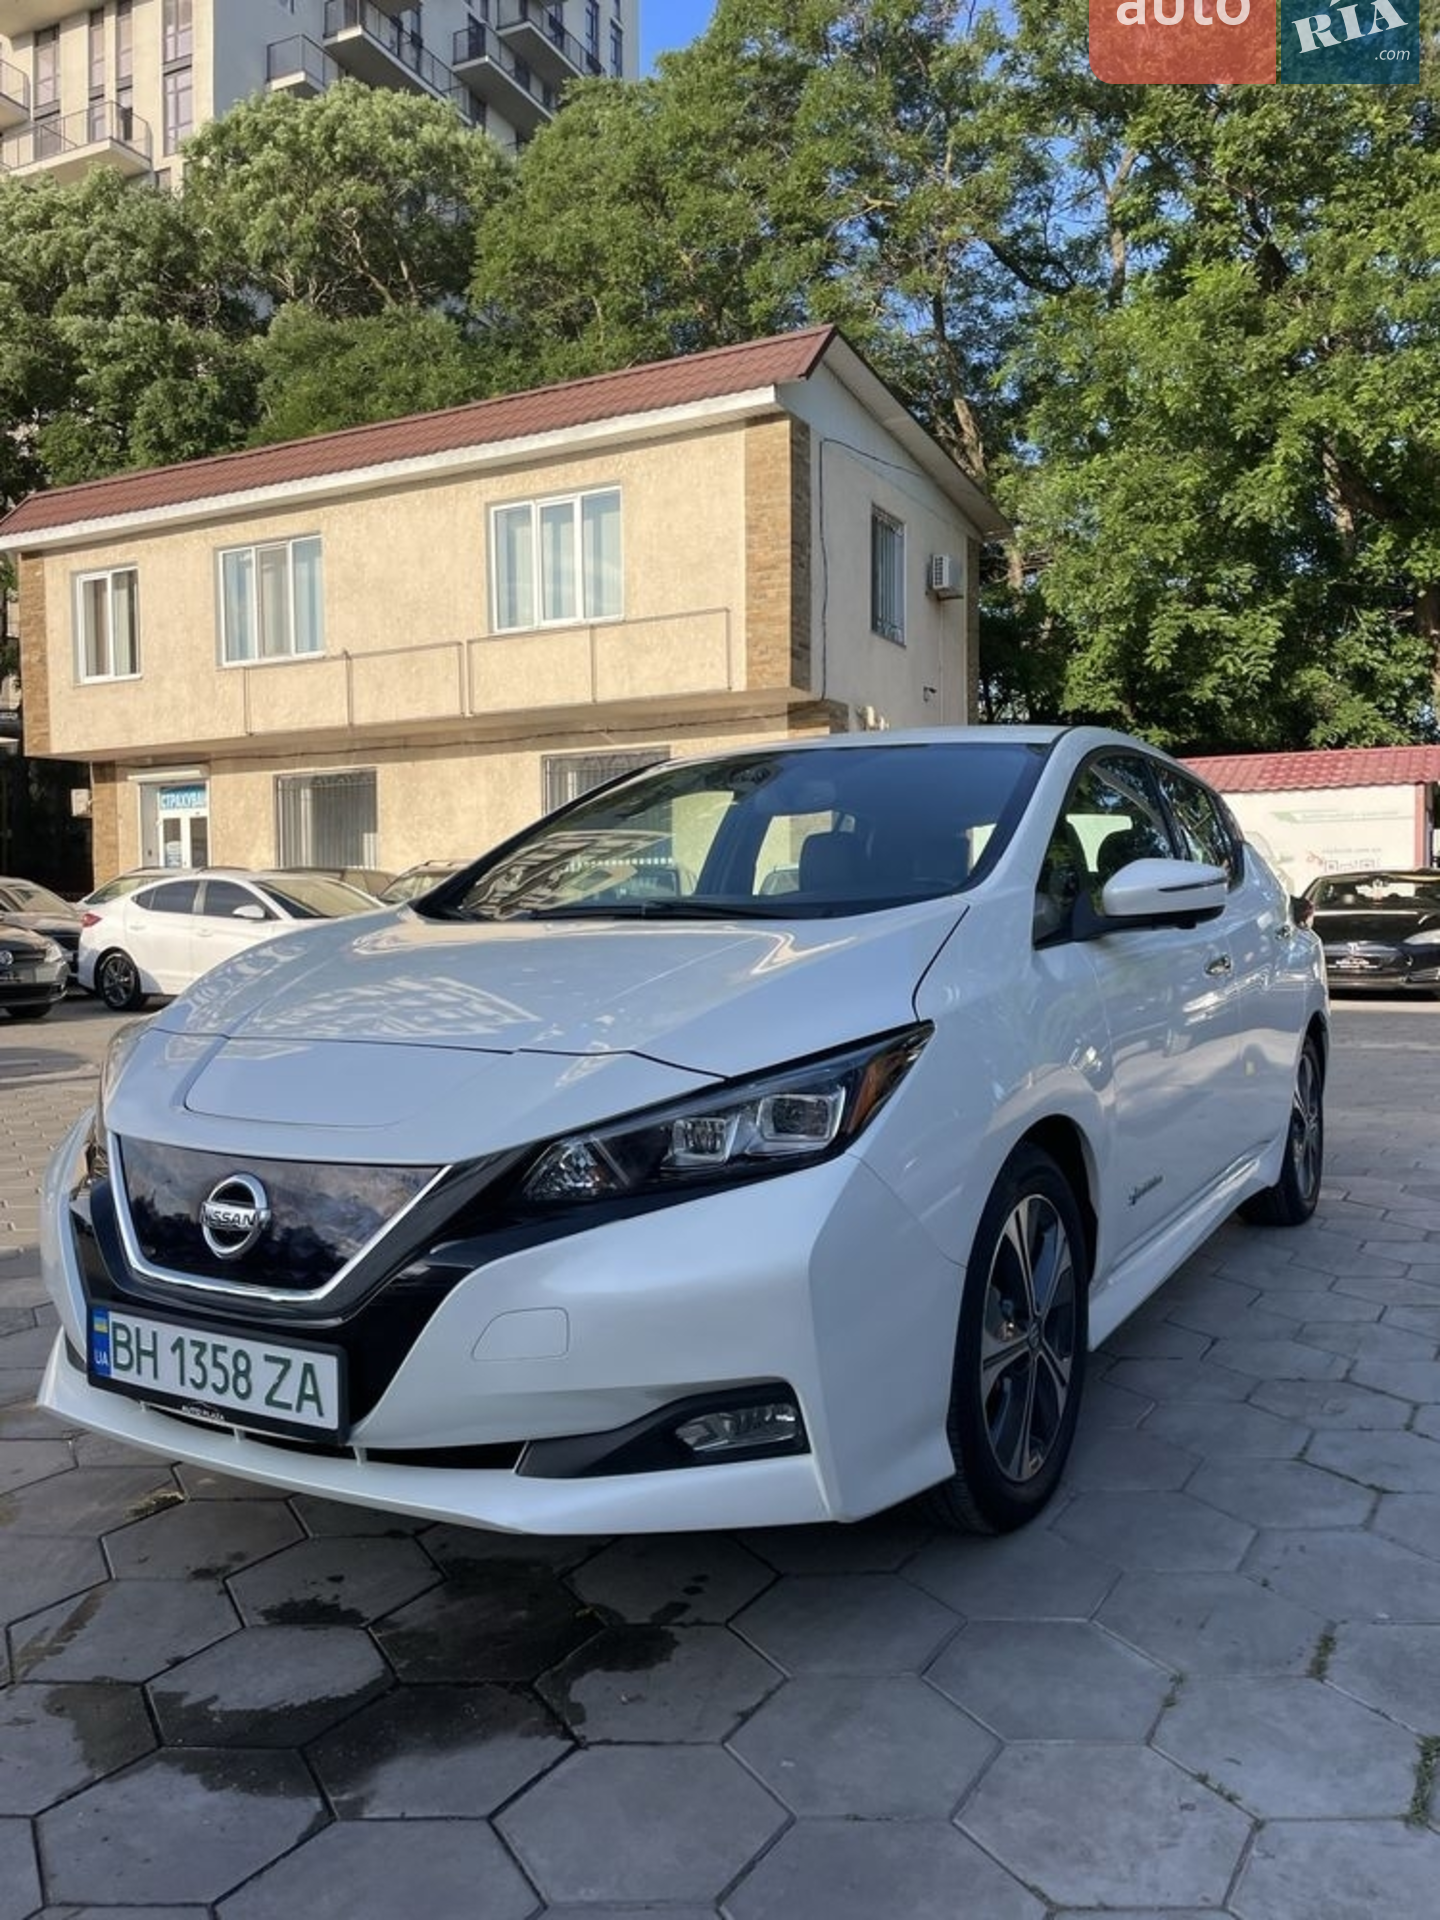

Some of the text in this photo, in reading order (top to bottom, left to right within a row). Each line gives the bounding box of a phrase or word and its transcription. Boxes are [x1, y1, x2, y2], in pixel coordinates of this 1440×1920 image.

[203, 1207, 255, 1227] NISSAN
[95, 1350, 109, 1366] UA
[111, 1321, 325, 1418] BH 1358 ZA
